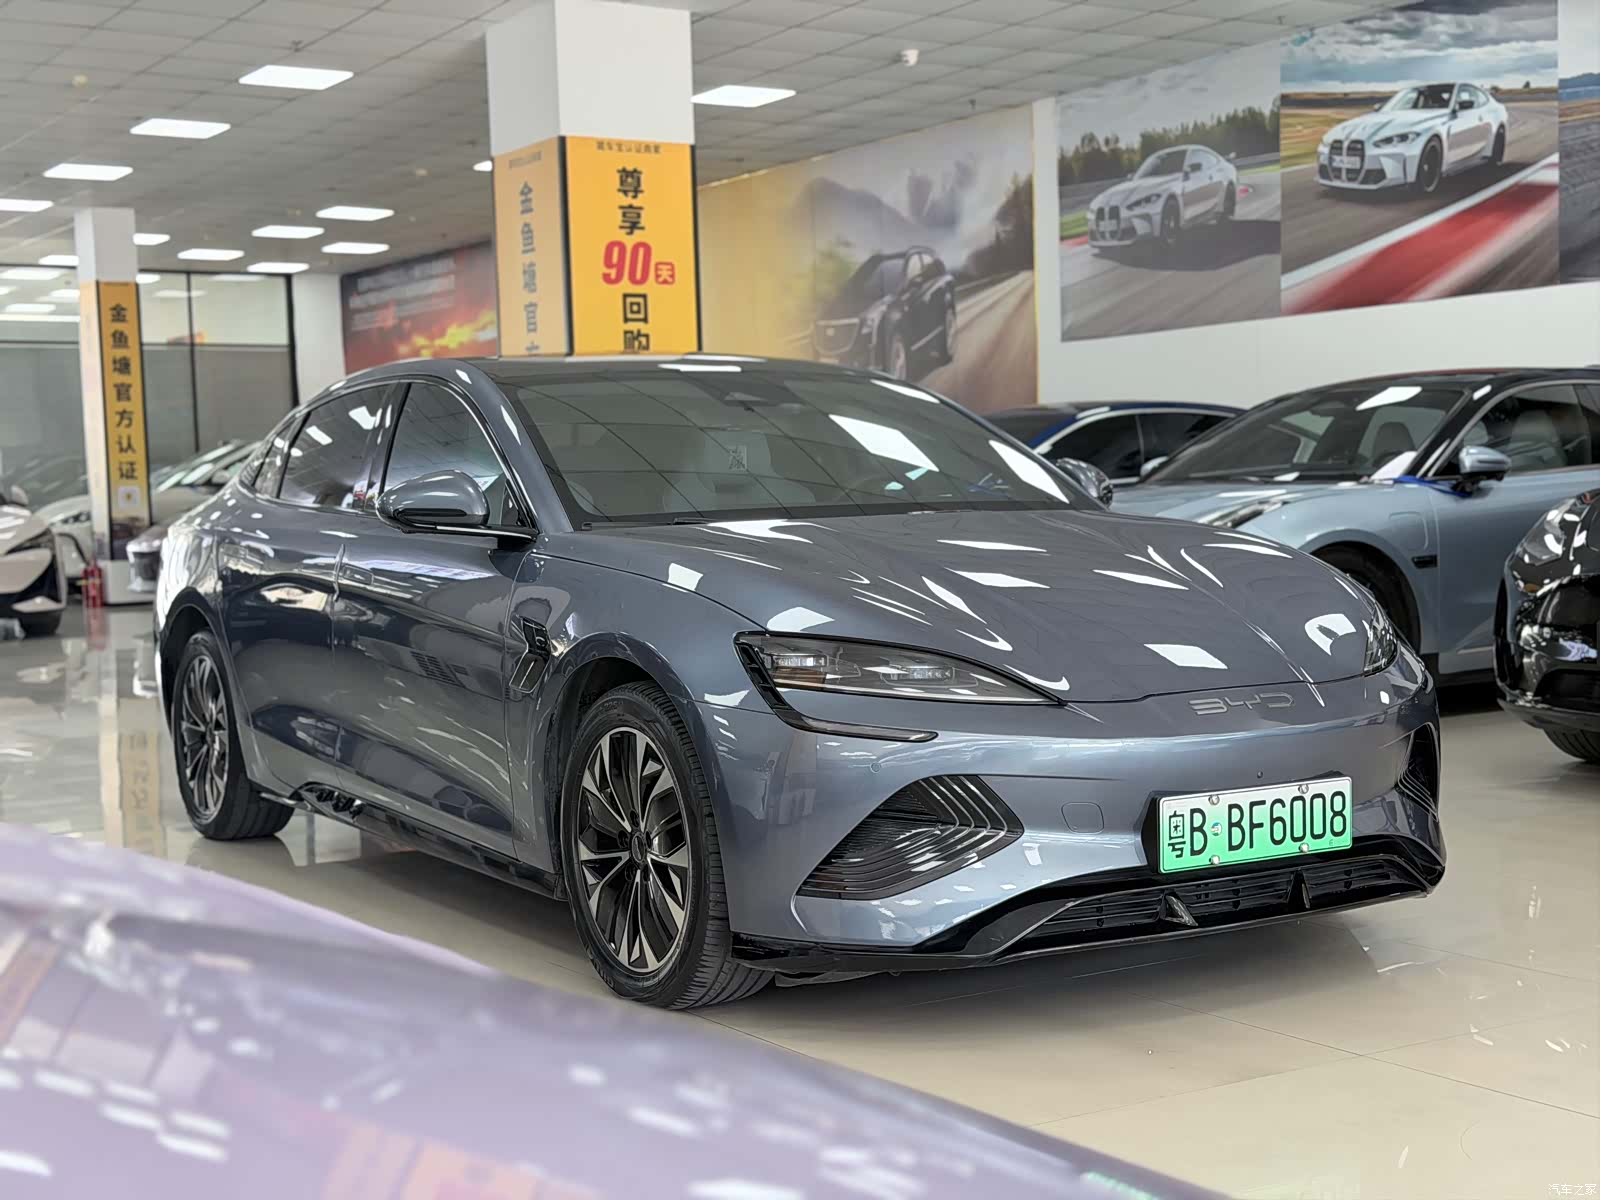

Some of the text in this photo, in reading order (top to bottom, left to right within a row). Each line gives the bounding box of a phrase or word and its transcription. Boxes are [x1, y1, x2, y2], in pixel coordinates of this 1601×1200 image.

[109, 303, 138, 480] 金鱼塘官方认证
[1188, 692, 1294, 715] BYD
